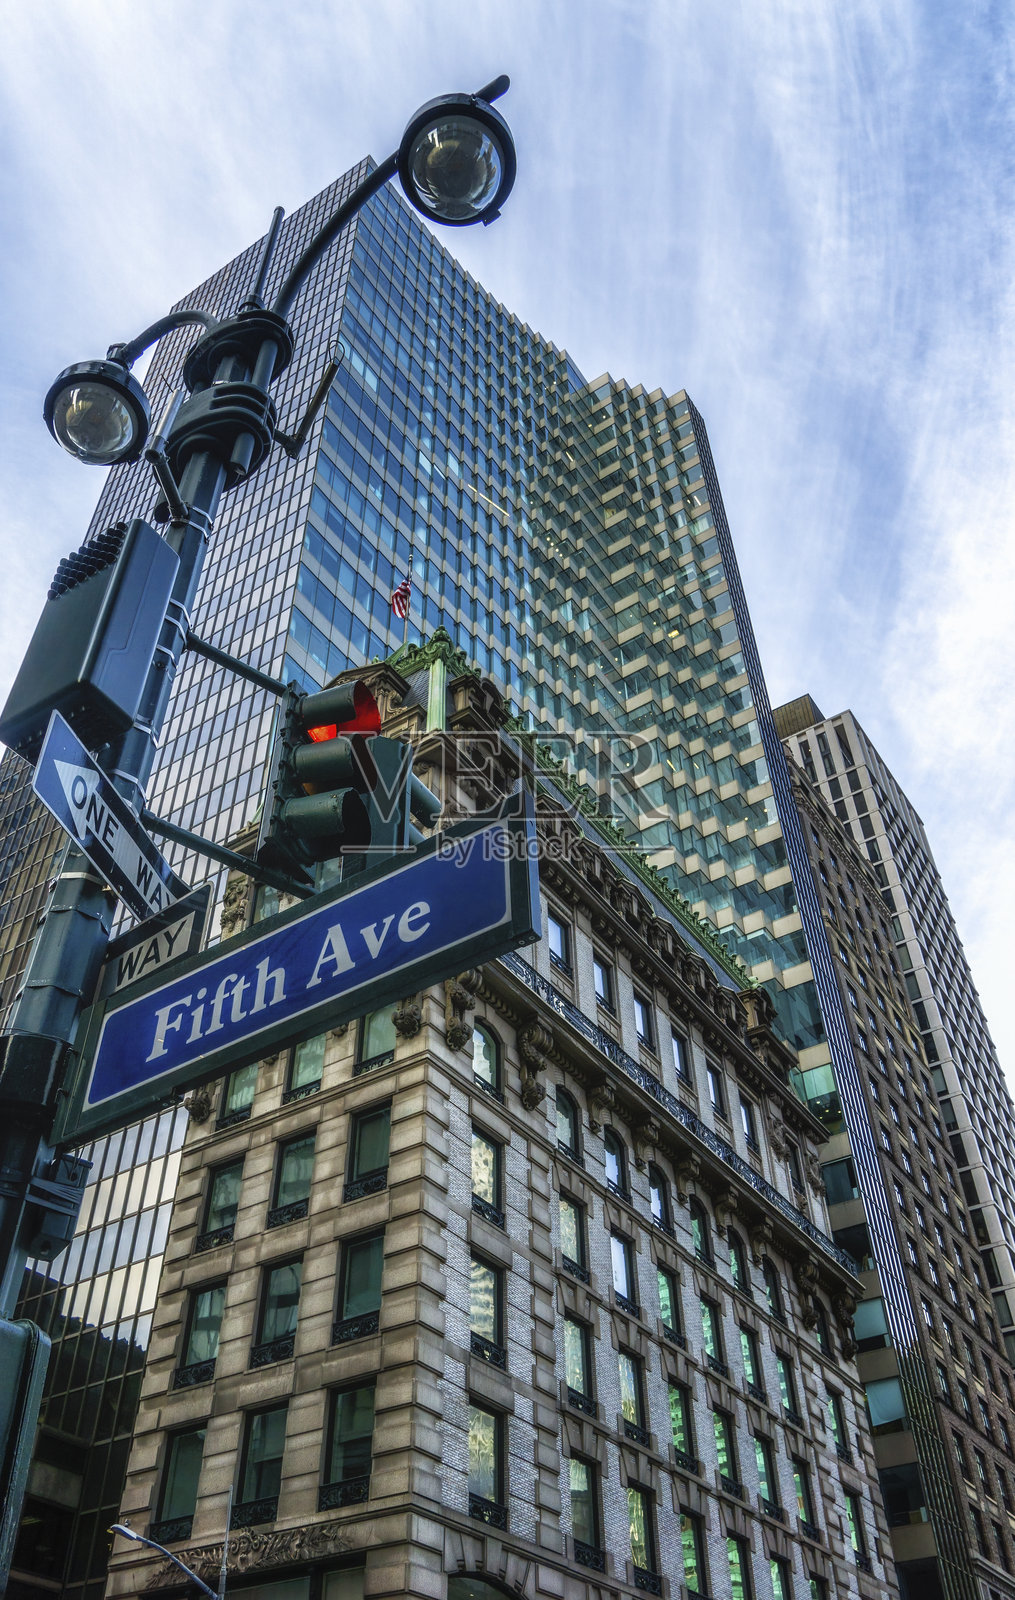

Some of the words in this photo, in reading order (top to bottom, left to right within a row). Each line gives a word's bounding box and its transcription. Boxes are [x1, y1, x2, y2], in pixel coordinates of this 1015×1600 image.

[71, 775, 119, 853] ONE
[116, 919, 187, 985] WAY
[145, 956, 287, 1062] Fifth
[306, 901, 431, 989] Ave
